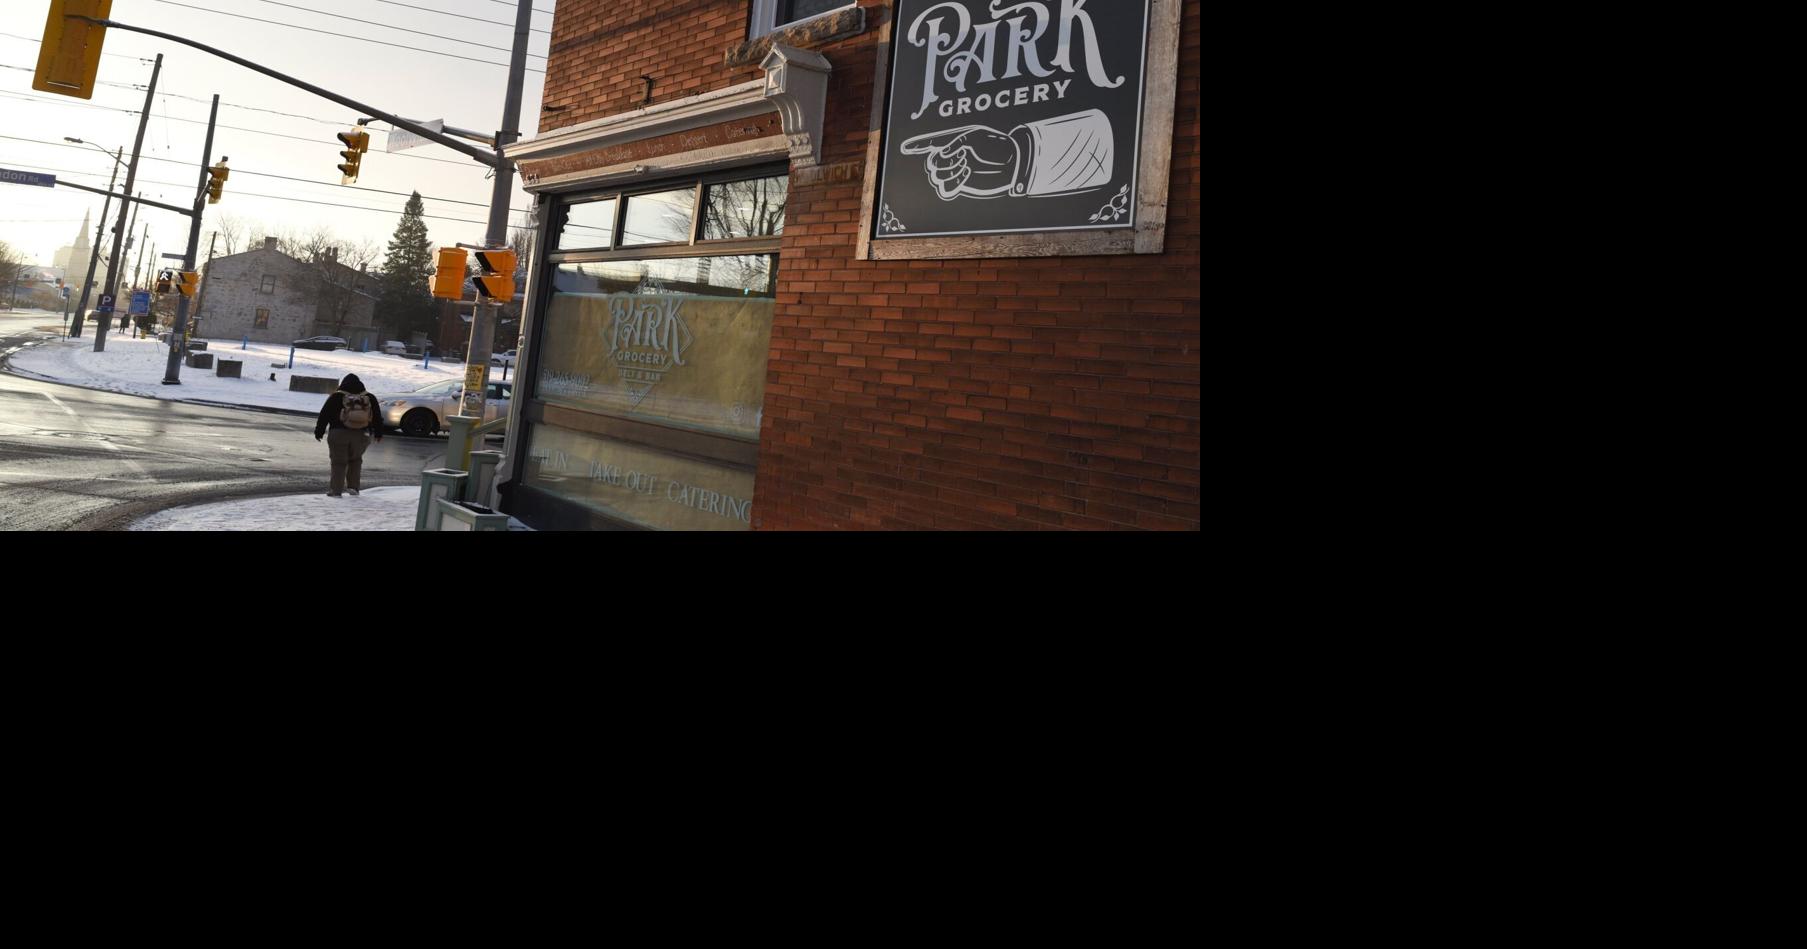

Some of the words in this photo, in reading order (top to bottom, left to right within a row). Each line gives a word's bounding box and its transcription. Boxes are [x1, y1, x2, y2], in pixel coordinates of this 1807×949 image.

[907, 0, 1125, 119] PARK
[939, 79, 1072, 117] GROCERY
[680, 133, 708, 148] Dessert
[724, 123, 760, 140] Catering
[0, 170, 27, 182] don
[101, 295, 112, 305] P
[606, 290, 686, 367] PARK
[617, 351, 668, 366] GROCERY
[554, 449, 569, 472] IN
[588, 457, 621, 486] TAKE
[625, 470, 657, 495] OUT
[667, 480, 752, 522] CATERING
